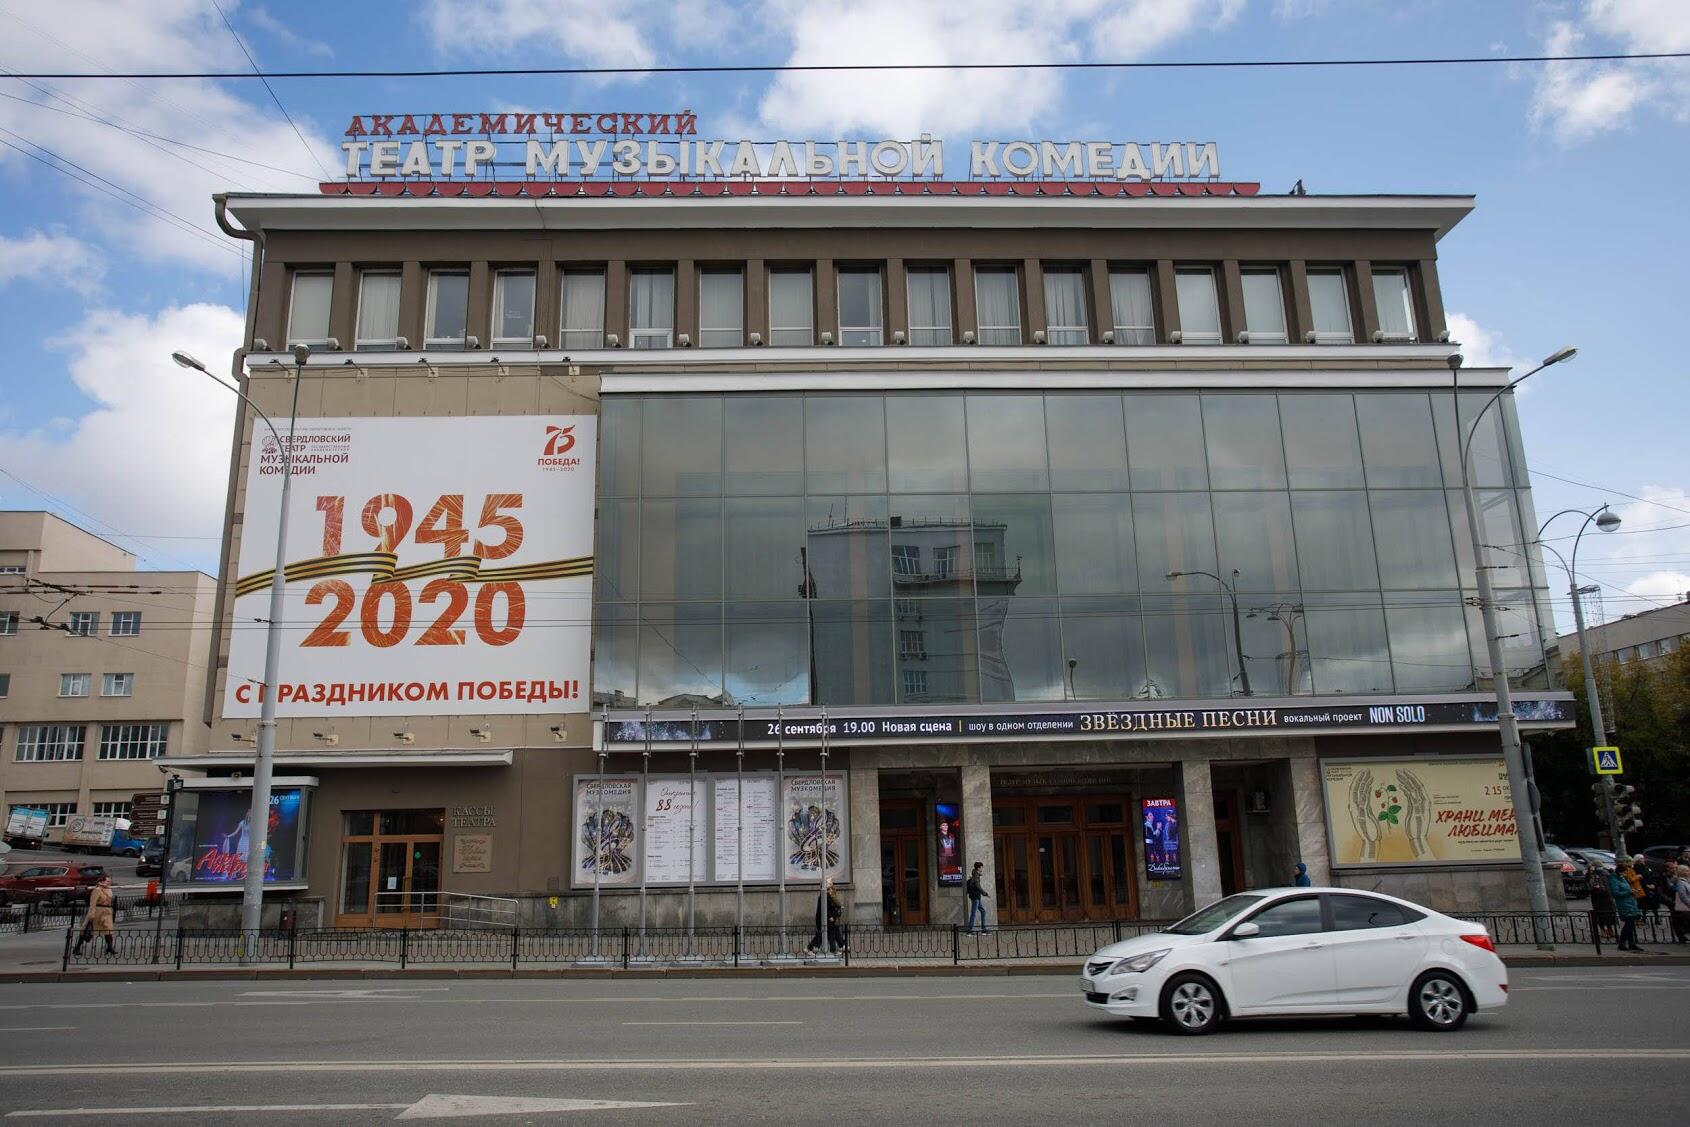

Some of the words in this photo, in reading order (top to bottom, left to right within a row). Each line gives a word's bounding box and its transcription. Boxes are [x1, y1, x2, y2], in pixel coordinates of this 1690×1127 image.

[345, 109, 697, 135] АКАДЕМИЧЕСКИЙ
[341, 139, 497, 177] ТЕАТР
[525, 133, 943, 177] МУЗЫКАЛЬНОЙ
[971, 140, 1220, 181] КОМЕДИИ
[280, 433, 351, 443] СВЕРДЛОВСКИЙ
[544, 425, 575, 455] 75
[281, 444, 306, 452] ЕАТР
[260, 452, 349, 464] МУЗЫКАЛЬНОЙ
[537, 458, 580, 466] ПОБЕДА!
[259, 466, 316, 476] КОМДИИ
[316, 493, 523, 560] 1945
[299, 578, 526, 648] 2020
[235, 684, 250, 704] С
[457, 679, 579, 703] ПОБЕДЫ!
[1080, 711, 1195, 731] ЗВЁЗДНЫЕ
[1202, 709, 1277, 728] ПЕСНИ
[1284, 713, 1330, 723] вокальный
[1333, 713, 1362, 723] проект
[1369, 707, 1394, 723] NON
[1396, 706, 1425, 723] SOLO
[767, 723, 781, 735] 26
[843, 721, 876, 733] 19.00
[882, 721, 917, 733] Новая
[920, 721, 952, 734] сцена
[969, 723, 986, 732] шоу
[997, 723, 1025, 732] одном
[1027, 721, 1074, 731] отделении
[453, 806, 494, 816] КАССЫ
[656, 799, 672, 811] 88
[452, 817, 496, 827] ТЕАТРА
[1435, 810, 1485, 823] ХРАНИ
[1448, 823, 1518, 838] ЛЮБИМА
